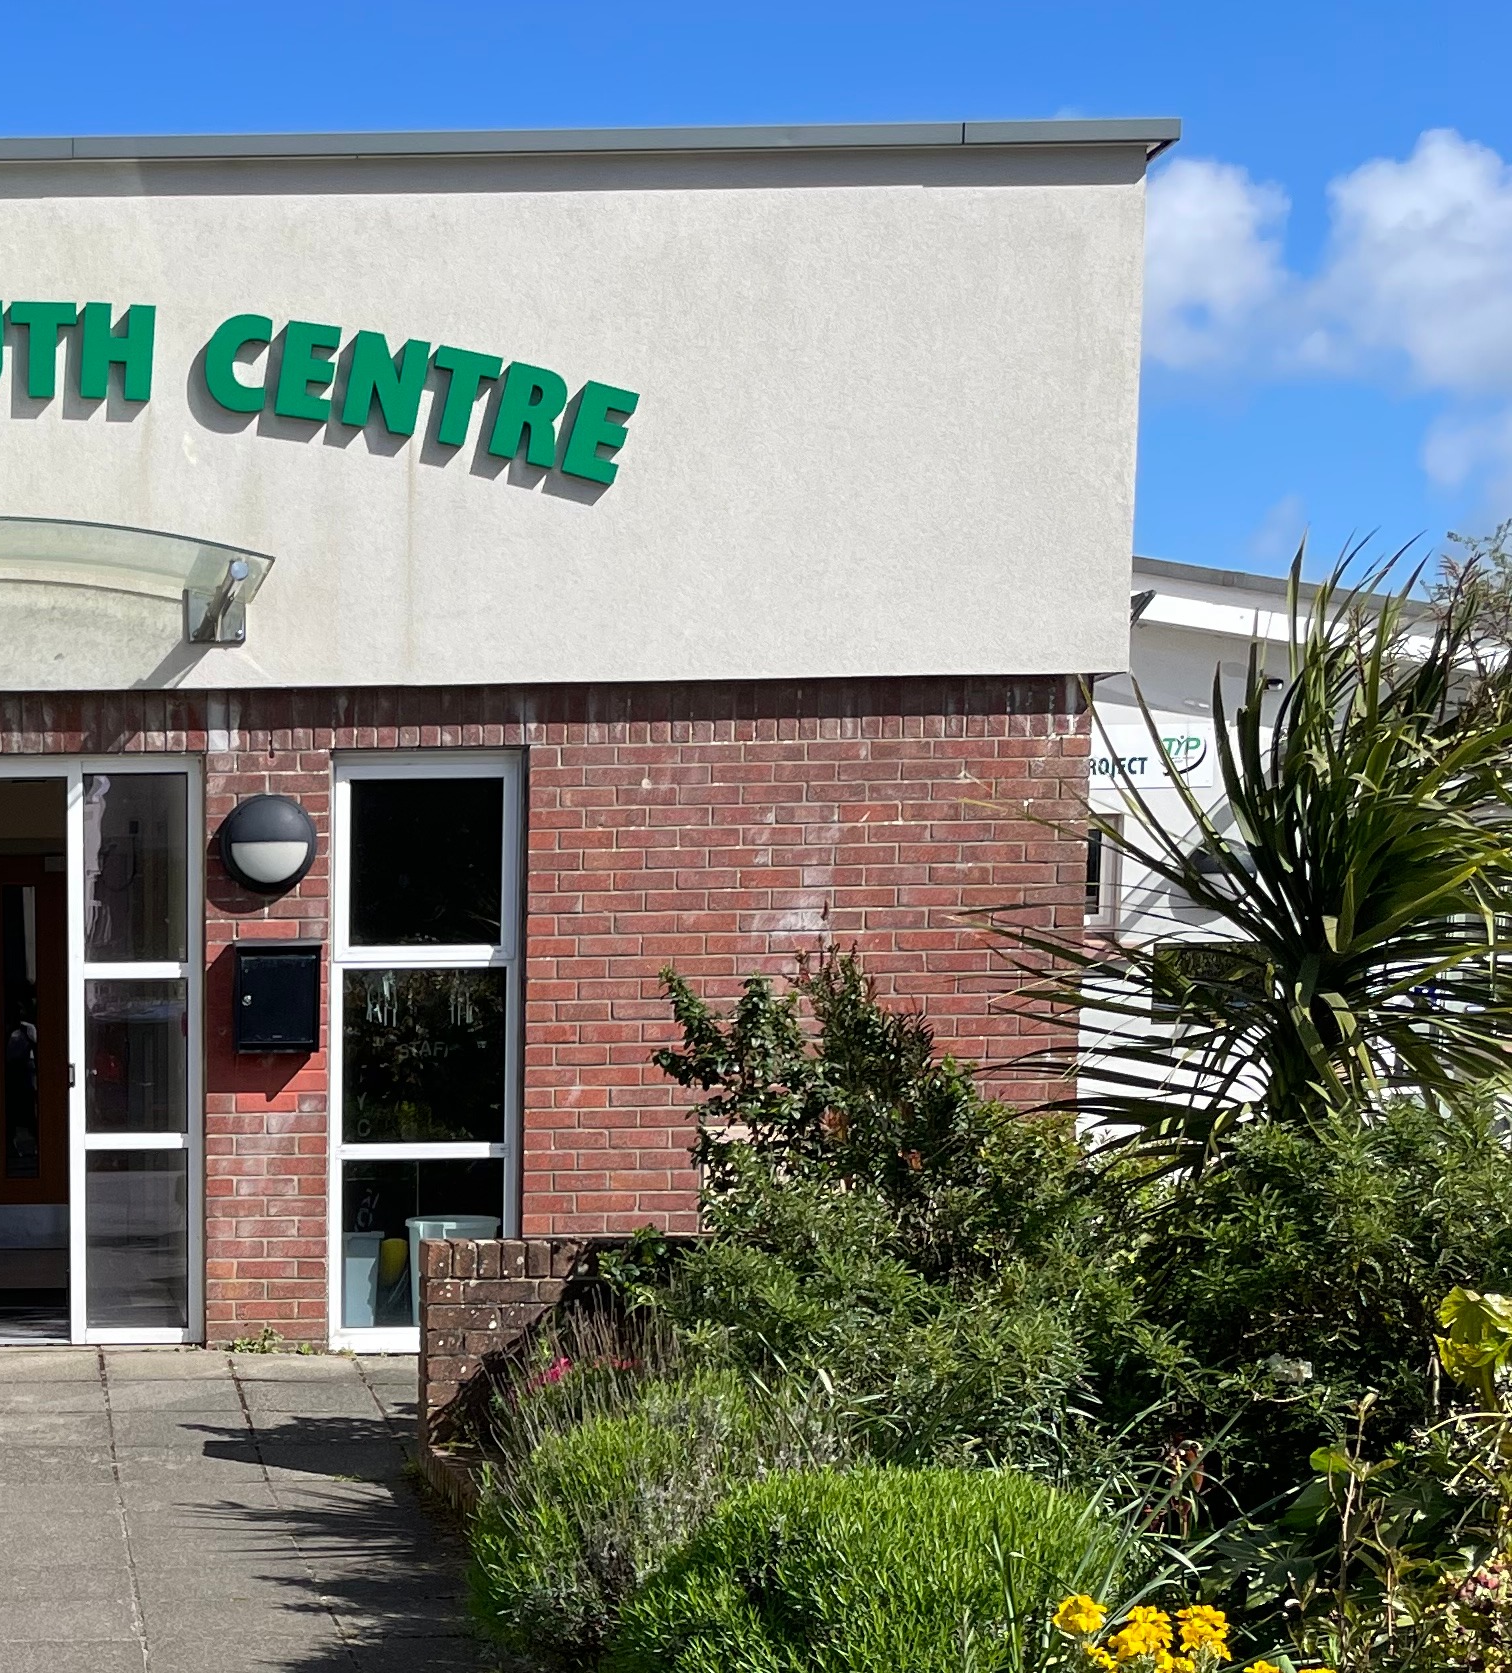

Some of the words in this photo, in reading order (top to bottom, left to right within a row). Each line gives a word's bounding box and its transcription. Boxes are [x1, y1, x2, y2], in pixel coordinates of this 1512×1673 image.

[205, 313, 640, 485] CENTRE
[1162, 736, 1201, 757] TYP
[1089, 756, 1148, 777] ROJECT
